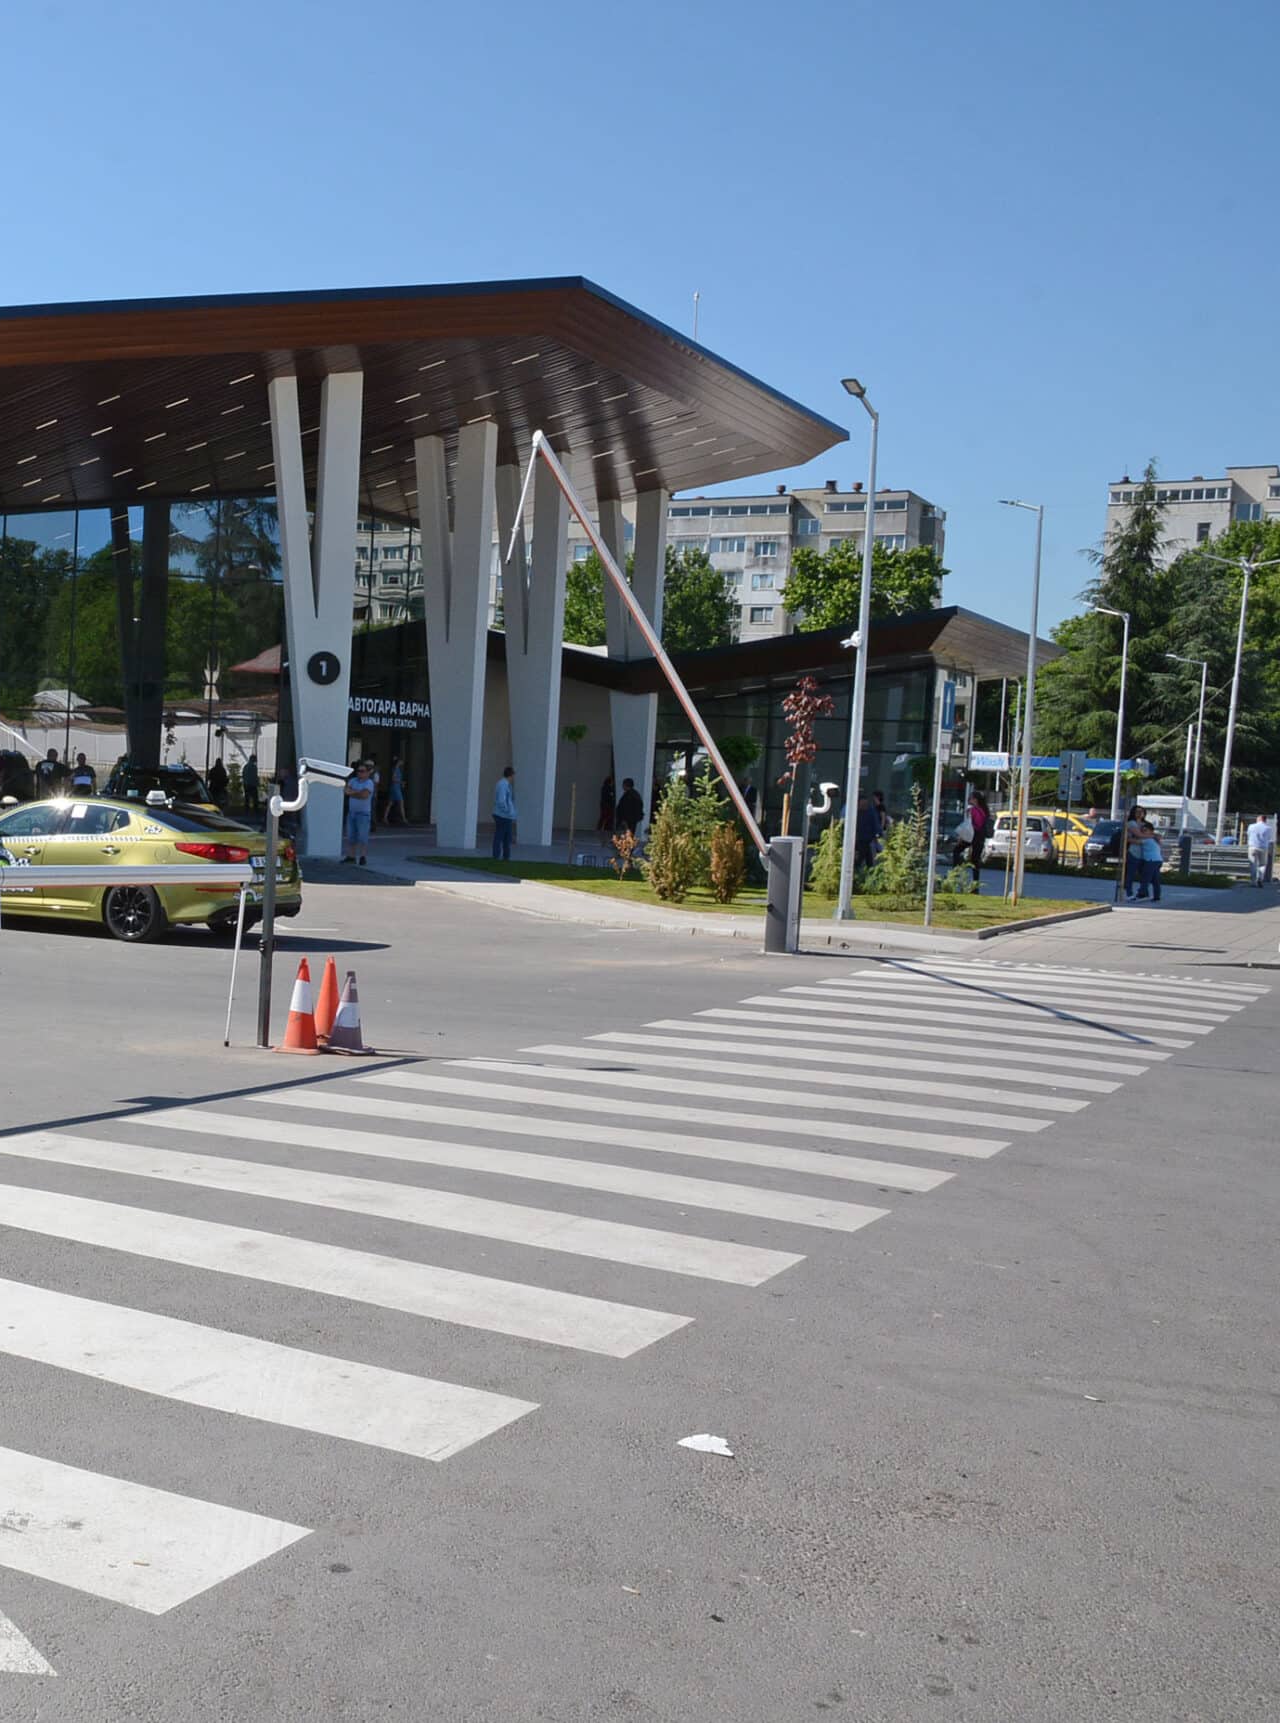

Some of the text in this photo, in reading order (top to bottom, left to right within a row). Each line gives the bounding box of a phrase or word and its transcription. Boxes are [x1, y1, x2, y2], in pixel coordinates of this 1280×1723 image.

[319, 661, 328, 676] 1
[349, 697, 431, 718] АВТОГАРА ВАРНА
[360, 716, 417, 729] VARNA BUS STATION
